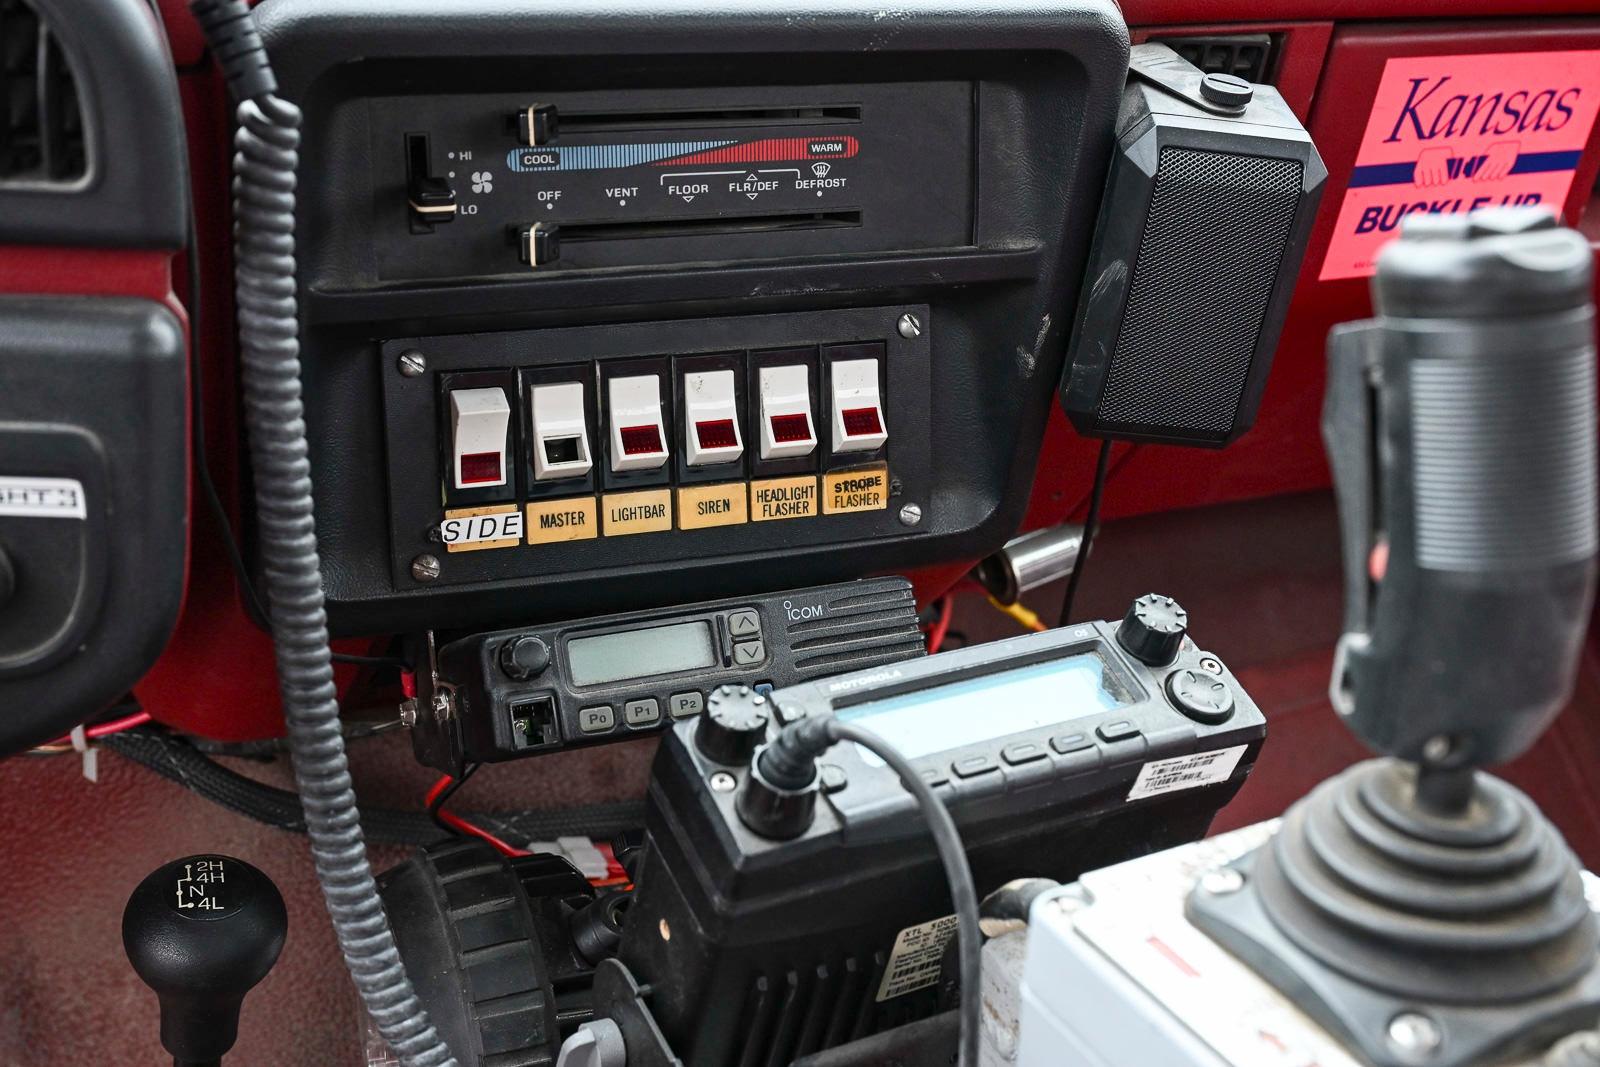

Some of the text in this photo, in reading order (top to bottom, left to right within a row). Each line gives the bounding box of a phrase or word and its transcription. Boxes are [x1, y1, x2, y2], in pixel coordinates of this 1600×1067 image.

[1382, 76, 1582, 143] Kansas
[810, 143, 842, 153] WARM
[459, 152, 472, 161] HI
[524, 154, 555, 165] COOL
[668, 184, 709, 195] FLOOR
[728, 180, 779, 193] FLR/DEF
[795, 178, 847, 189] DEFROST
[537, 190, 562, 201] OFF
[605, 187, 639, 198] VENT
[460, 205, 478, 215] LO
[757, 485, 815, 503] HEADLIGHT
[697, 498, 731, 515] SIREN
[834, 492, 880, 509] FLASHER
[611, 504, 666, 523] LIGHTBAR
[763, 501, 809, 517] FLASHER
[540, 511, 585, 529] MASTER
[444, 515, 520, 542] SIDE
[829, 670, 903, 692] MOTOROLA
[680, 699, 697, 710] P2
[634, 706, 651, 717] P1
[196, 860, 224, 872] 2H
[196, 872, 225, 883] 4H
[189, 884, 204, 897] N
[197, 896, 225, 910] 4L
